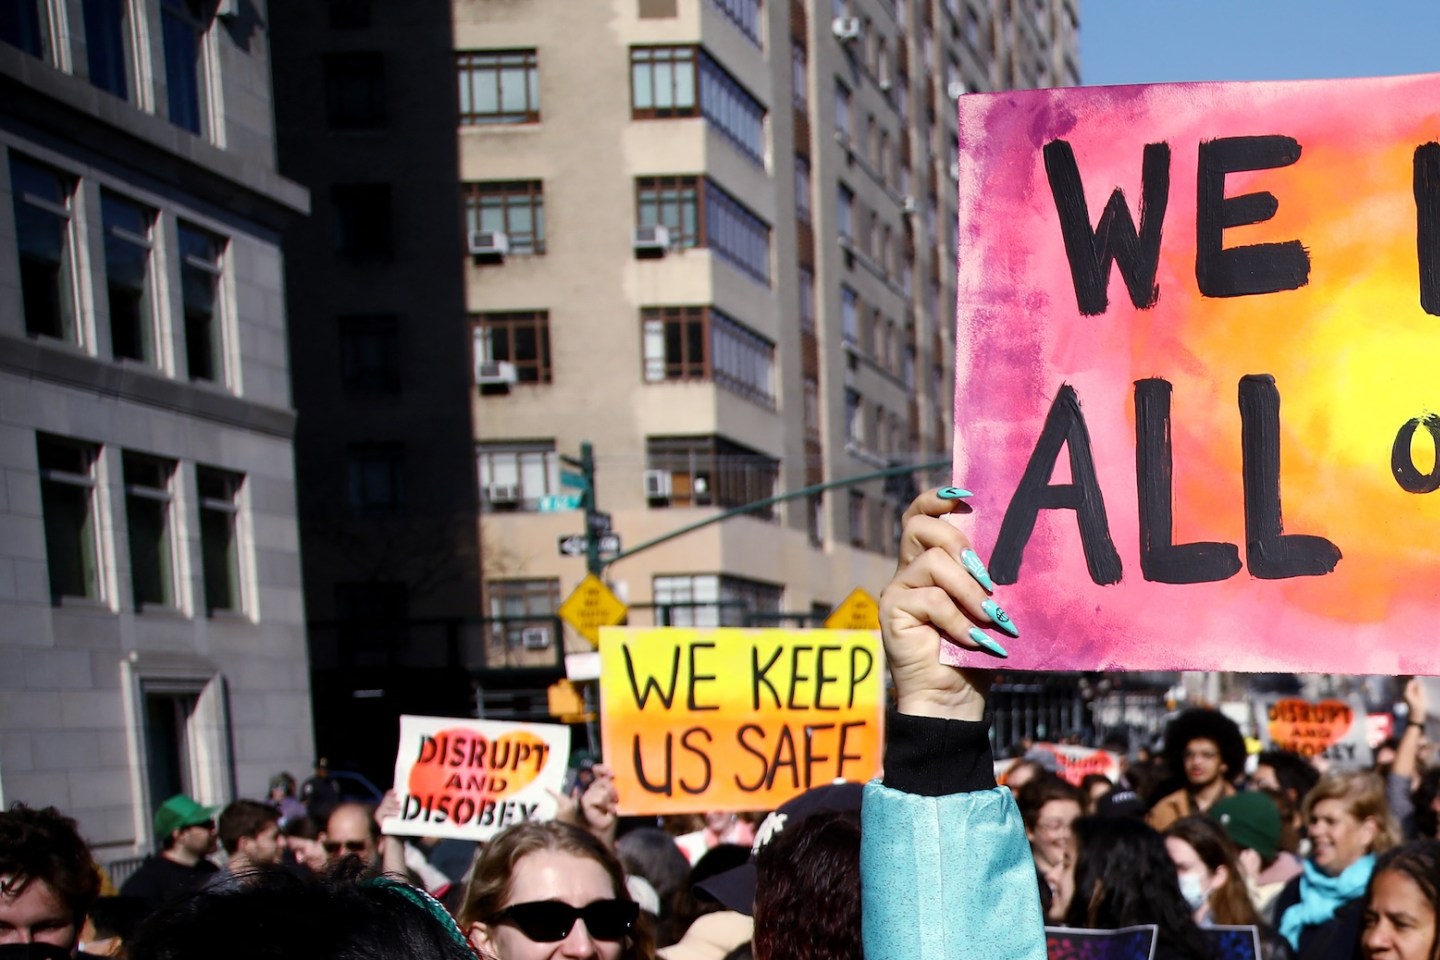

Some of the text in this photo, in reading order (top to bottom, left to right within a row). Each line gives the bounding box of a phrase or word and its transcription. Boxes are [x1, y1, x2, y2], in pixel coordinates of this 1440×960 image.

[1042, 134, 1312, 317] WE
[989, 373, 1344, 587] ALL
[621, 642, 874, 711] WE KEEP
[417, 734, 550, 772] DISRUPT
[444, 773, 508, 793] AND
[632, 726, 713, 797] US
